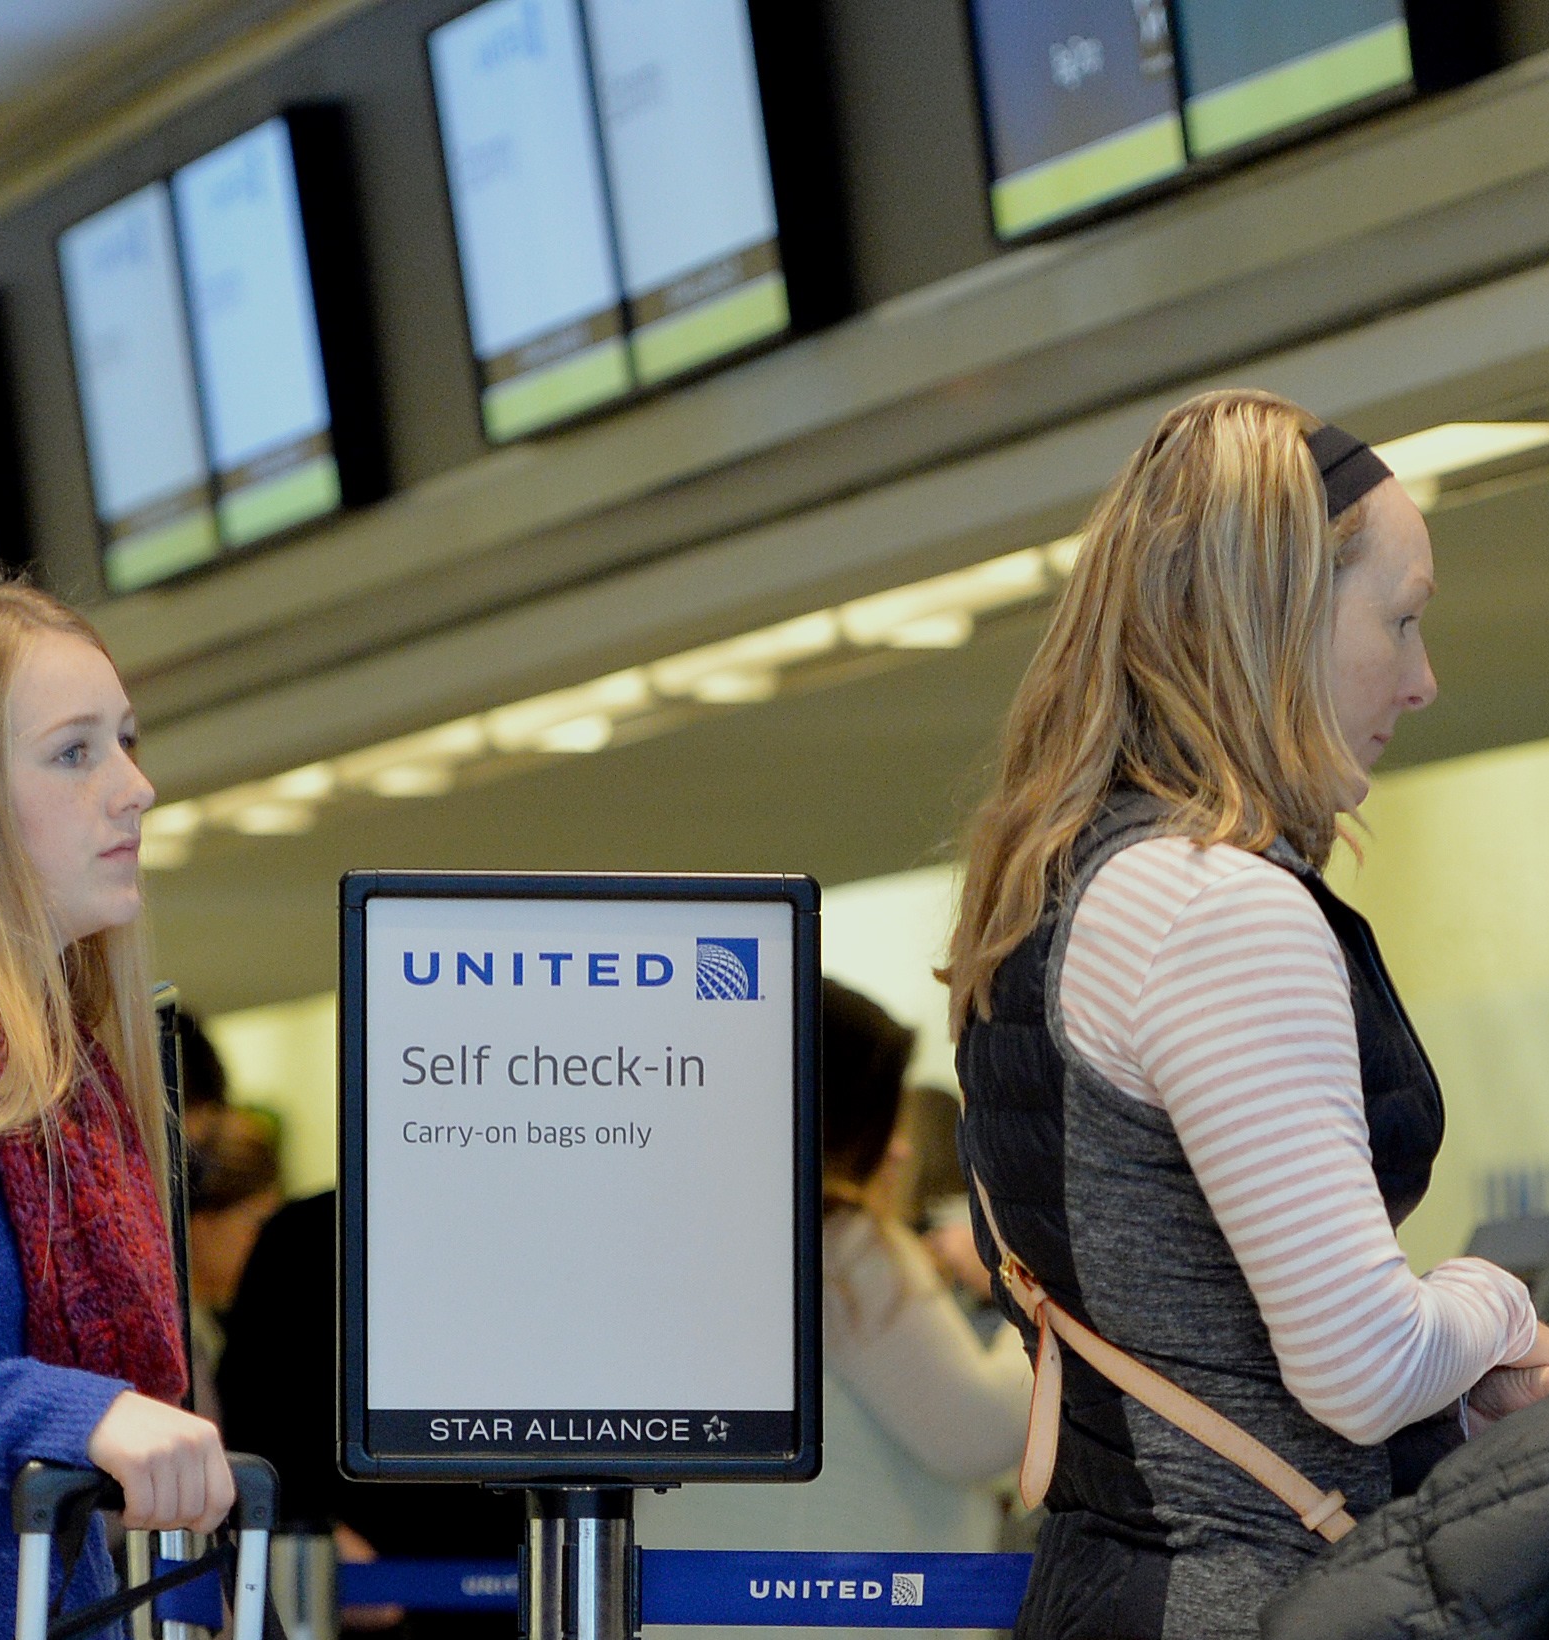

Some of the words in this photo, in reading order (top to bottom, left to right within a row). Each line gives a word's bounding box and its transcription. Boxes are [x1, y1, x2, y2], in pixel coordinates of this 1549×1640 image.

[402, 951, 675, 987] UNITED
[401, 1045, 492, 1087] Self
[507, 1045, 706, 1087] check-in
[402, 1120, 518, 1148] Carry-on
[526, 1119, 586, 1148] bags
[595, 1120, 652, 1149] only
[429, 1418, 513, 1442] STAR
[525, 1418, 691, 1442] ALLIANCE
[749, 1580, 884, 1600] UNITED
